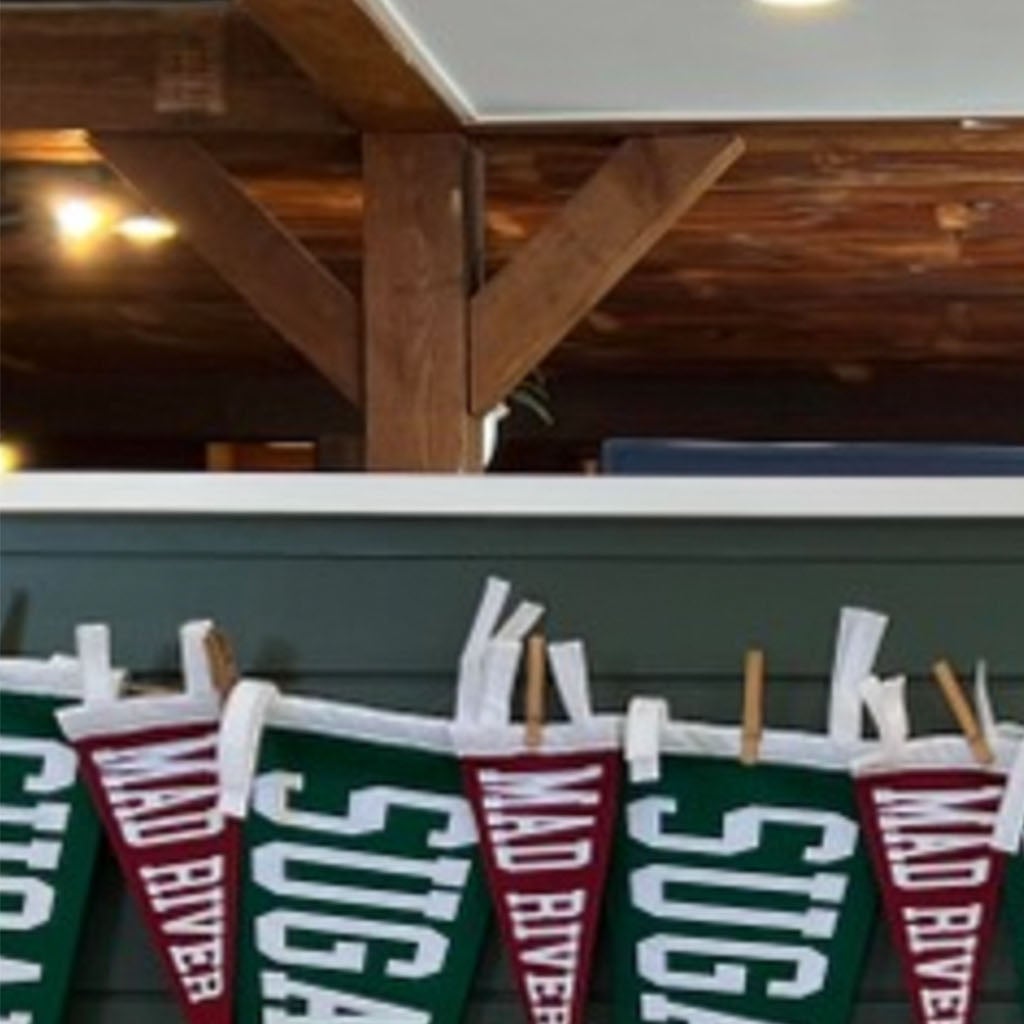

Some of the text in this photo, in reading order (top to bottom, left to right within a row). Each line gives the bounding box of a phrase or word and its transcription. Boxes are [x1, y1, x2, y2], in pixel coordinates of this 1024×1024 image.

[92, 734, 226, 1004] MAD RIVER
[477, 754, 603, 873] MAD
[872, 784, 1004, 890] MAD
